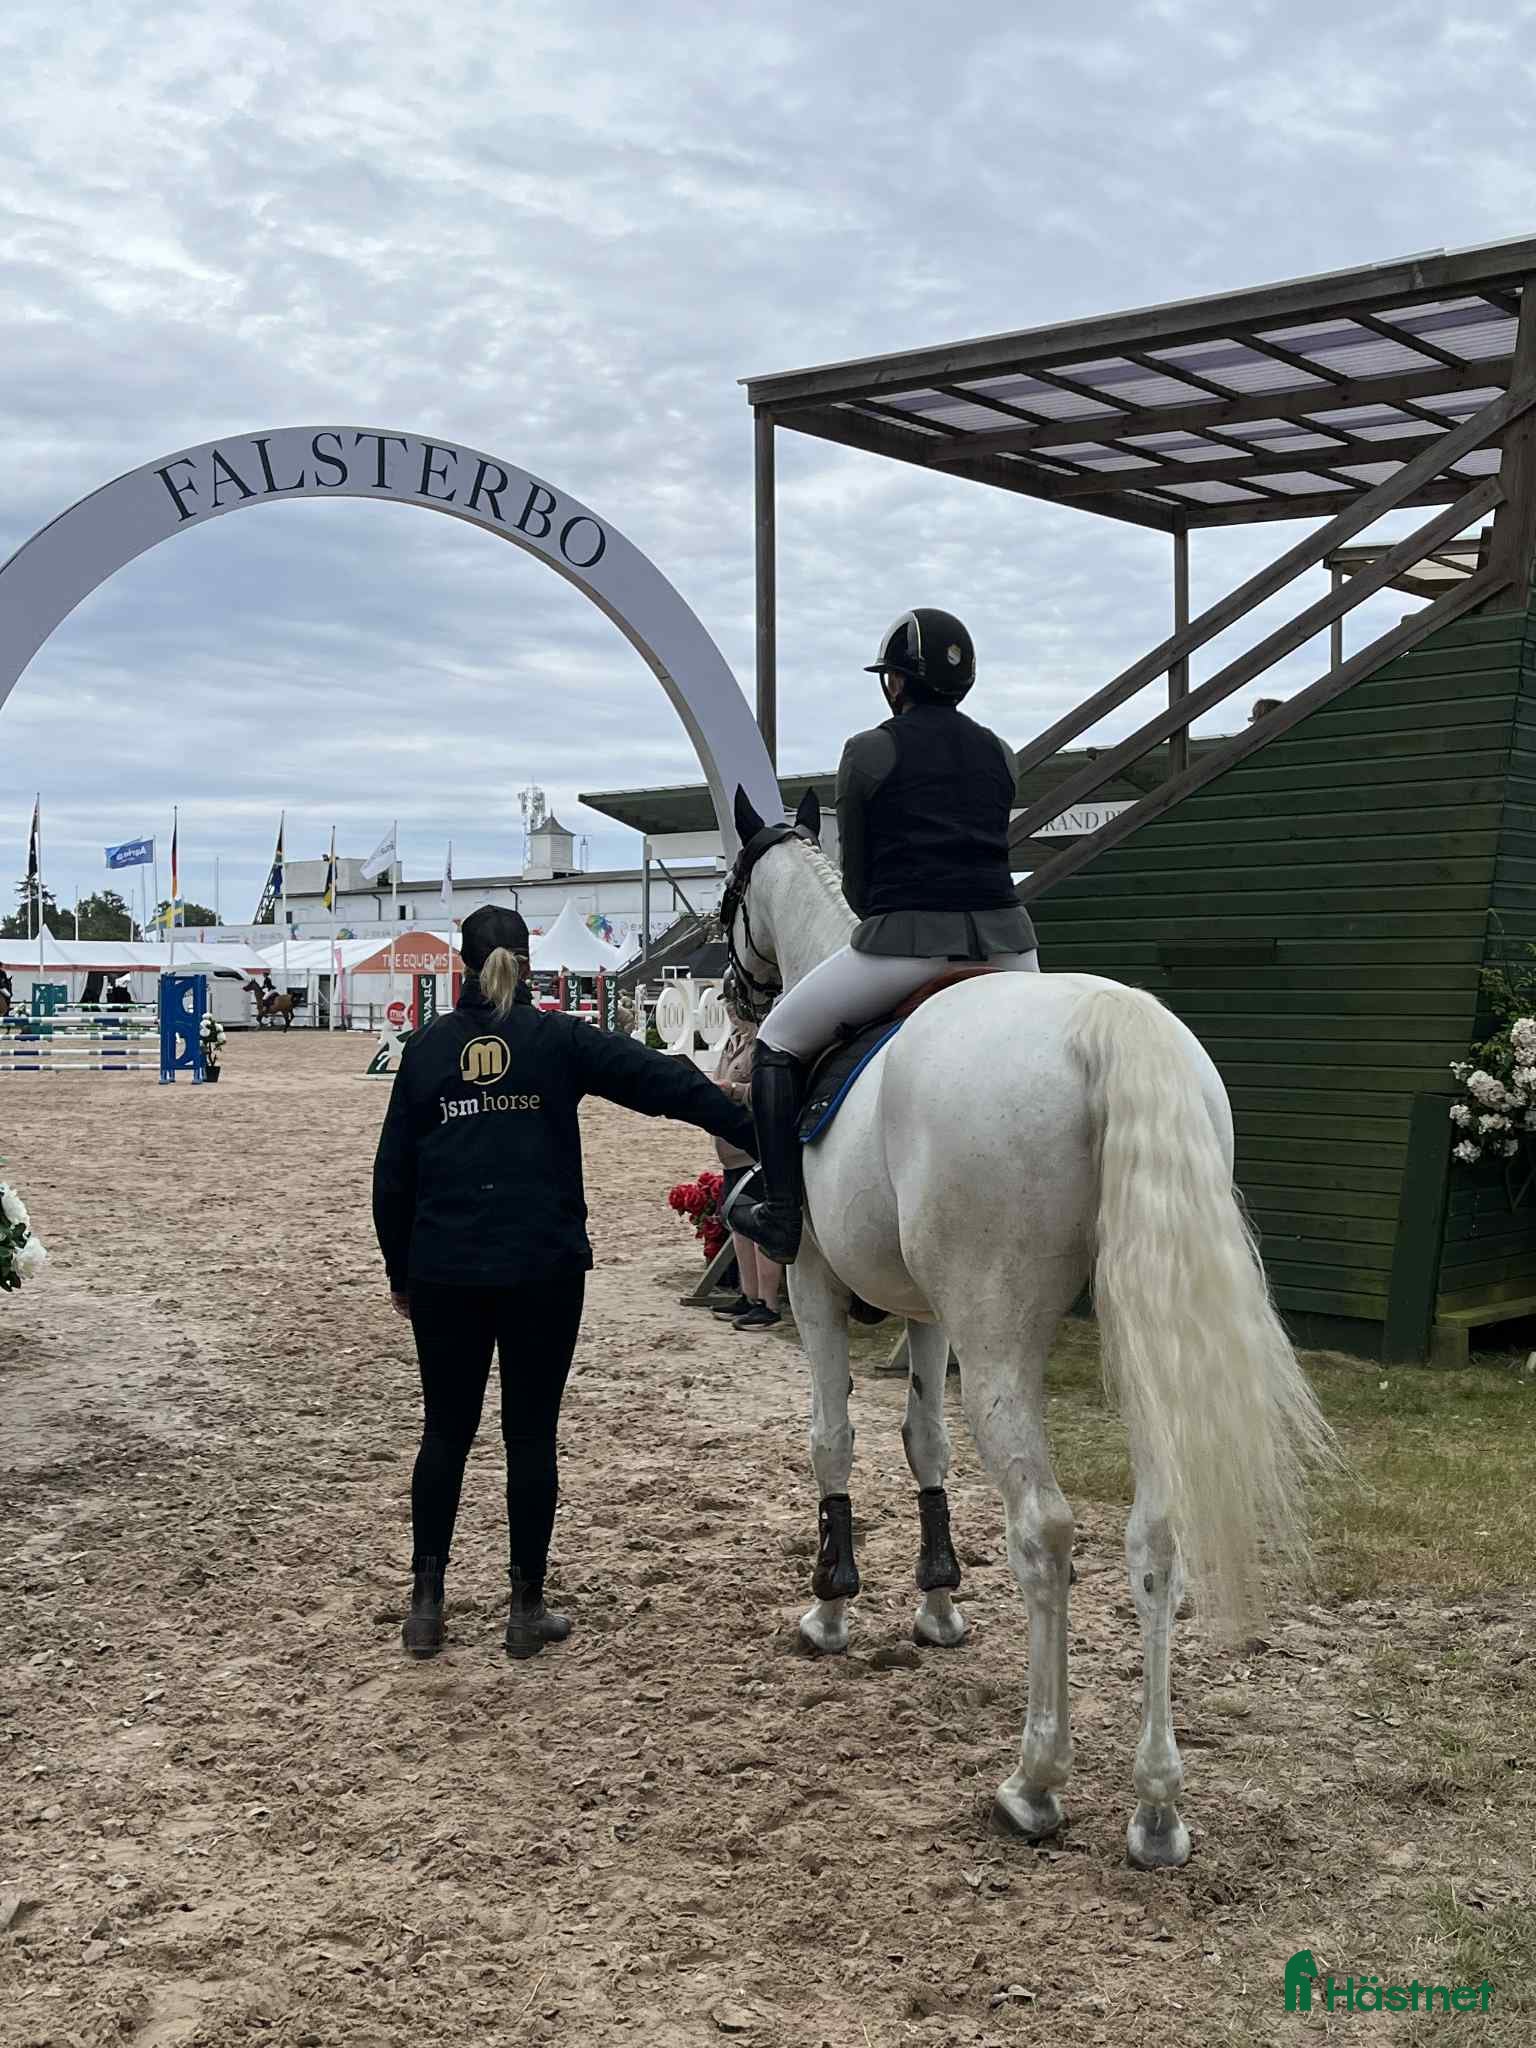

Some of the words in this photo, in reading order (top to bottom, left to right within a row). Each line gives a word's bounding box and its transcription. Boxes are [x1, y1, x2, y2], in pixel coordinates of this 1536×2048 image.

[154, 432, 607, 568] FALSTERBO
[439, 1097, 479, 1124] jsm
[481, 1091, 541, 1113] horse
